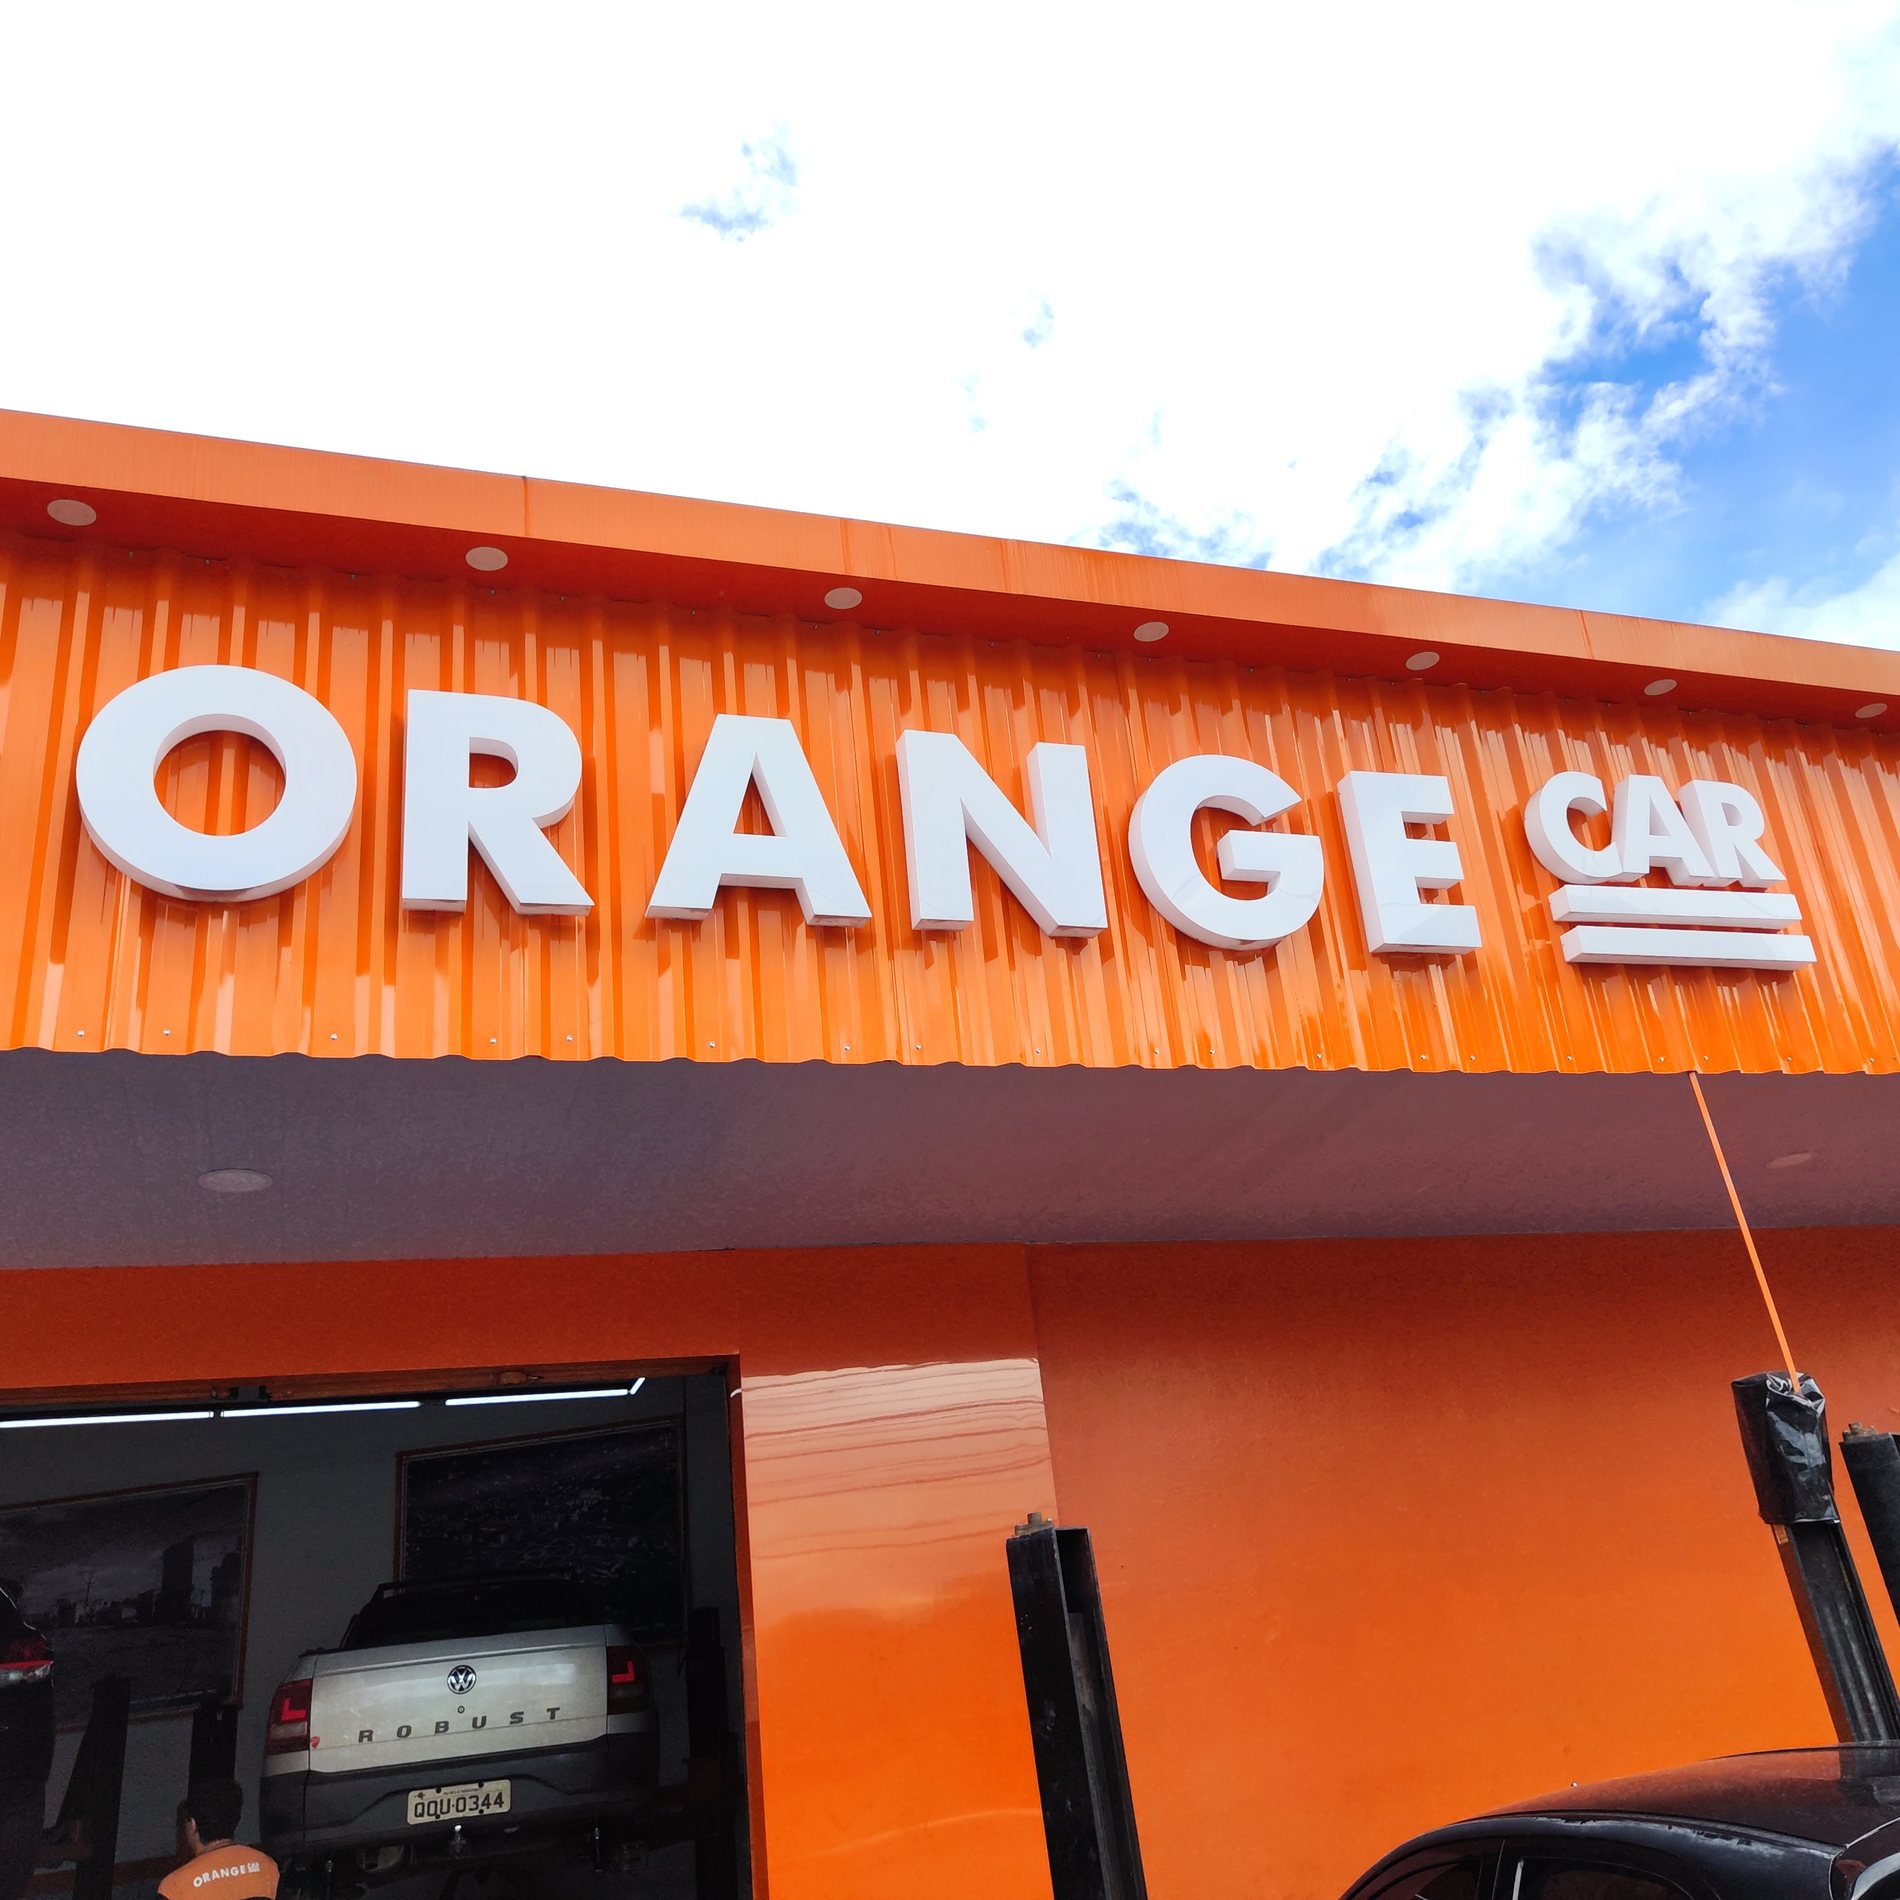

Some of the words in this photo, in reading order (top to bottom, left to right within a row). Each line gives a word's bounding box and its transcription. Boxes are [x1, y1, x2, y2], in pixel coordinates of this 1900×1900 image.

[75, 664, 1482, 956] ORANGE
[1524, 770, 1788, 888] CAR
[358, 1706, 560, 1743] ROBUST
[193, 1864, 246, 1888] ORANGE
